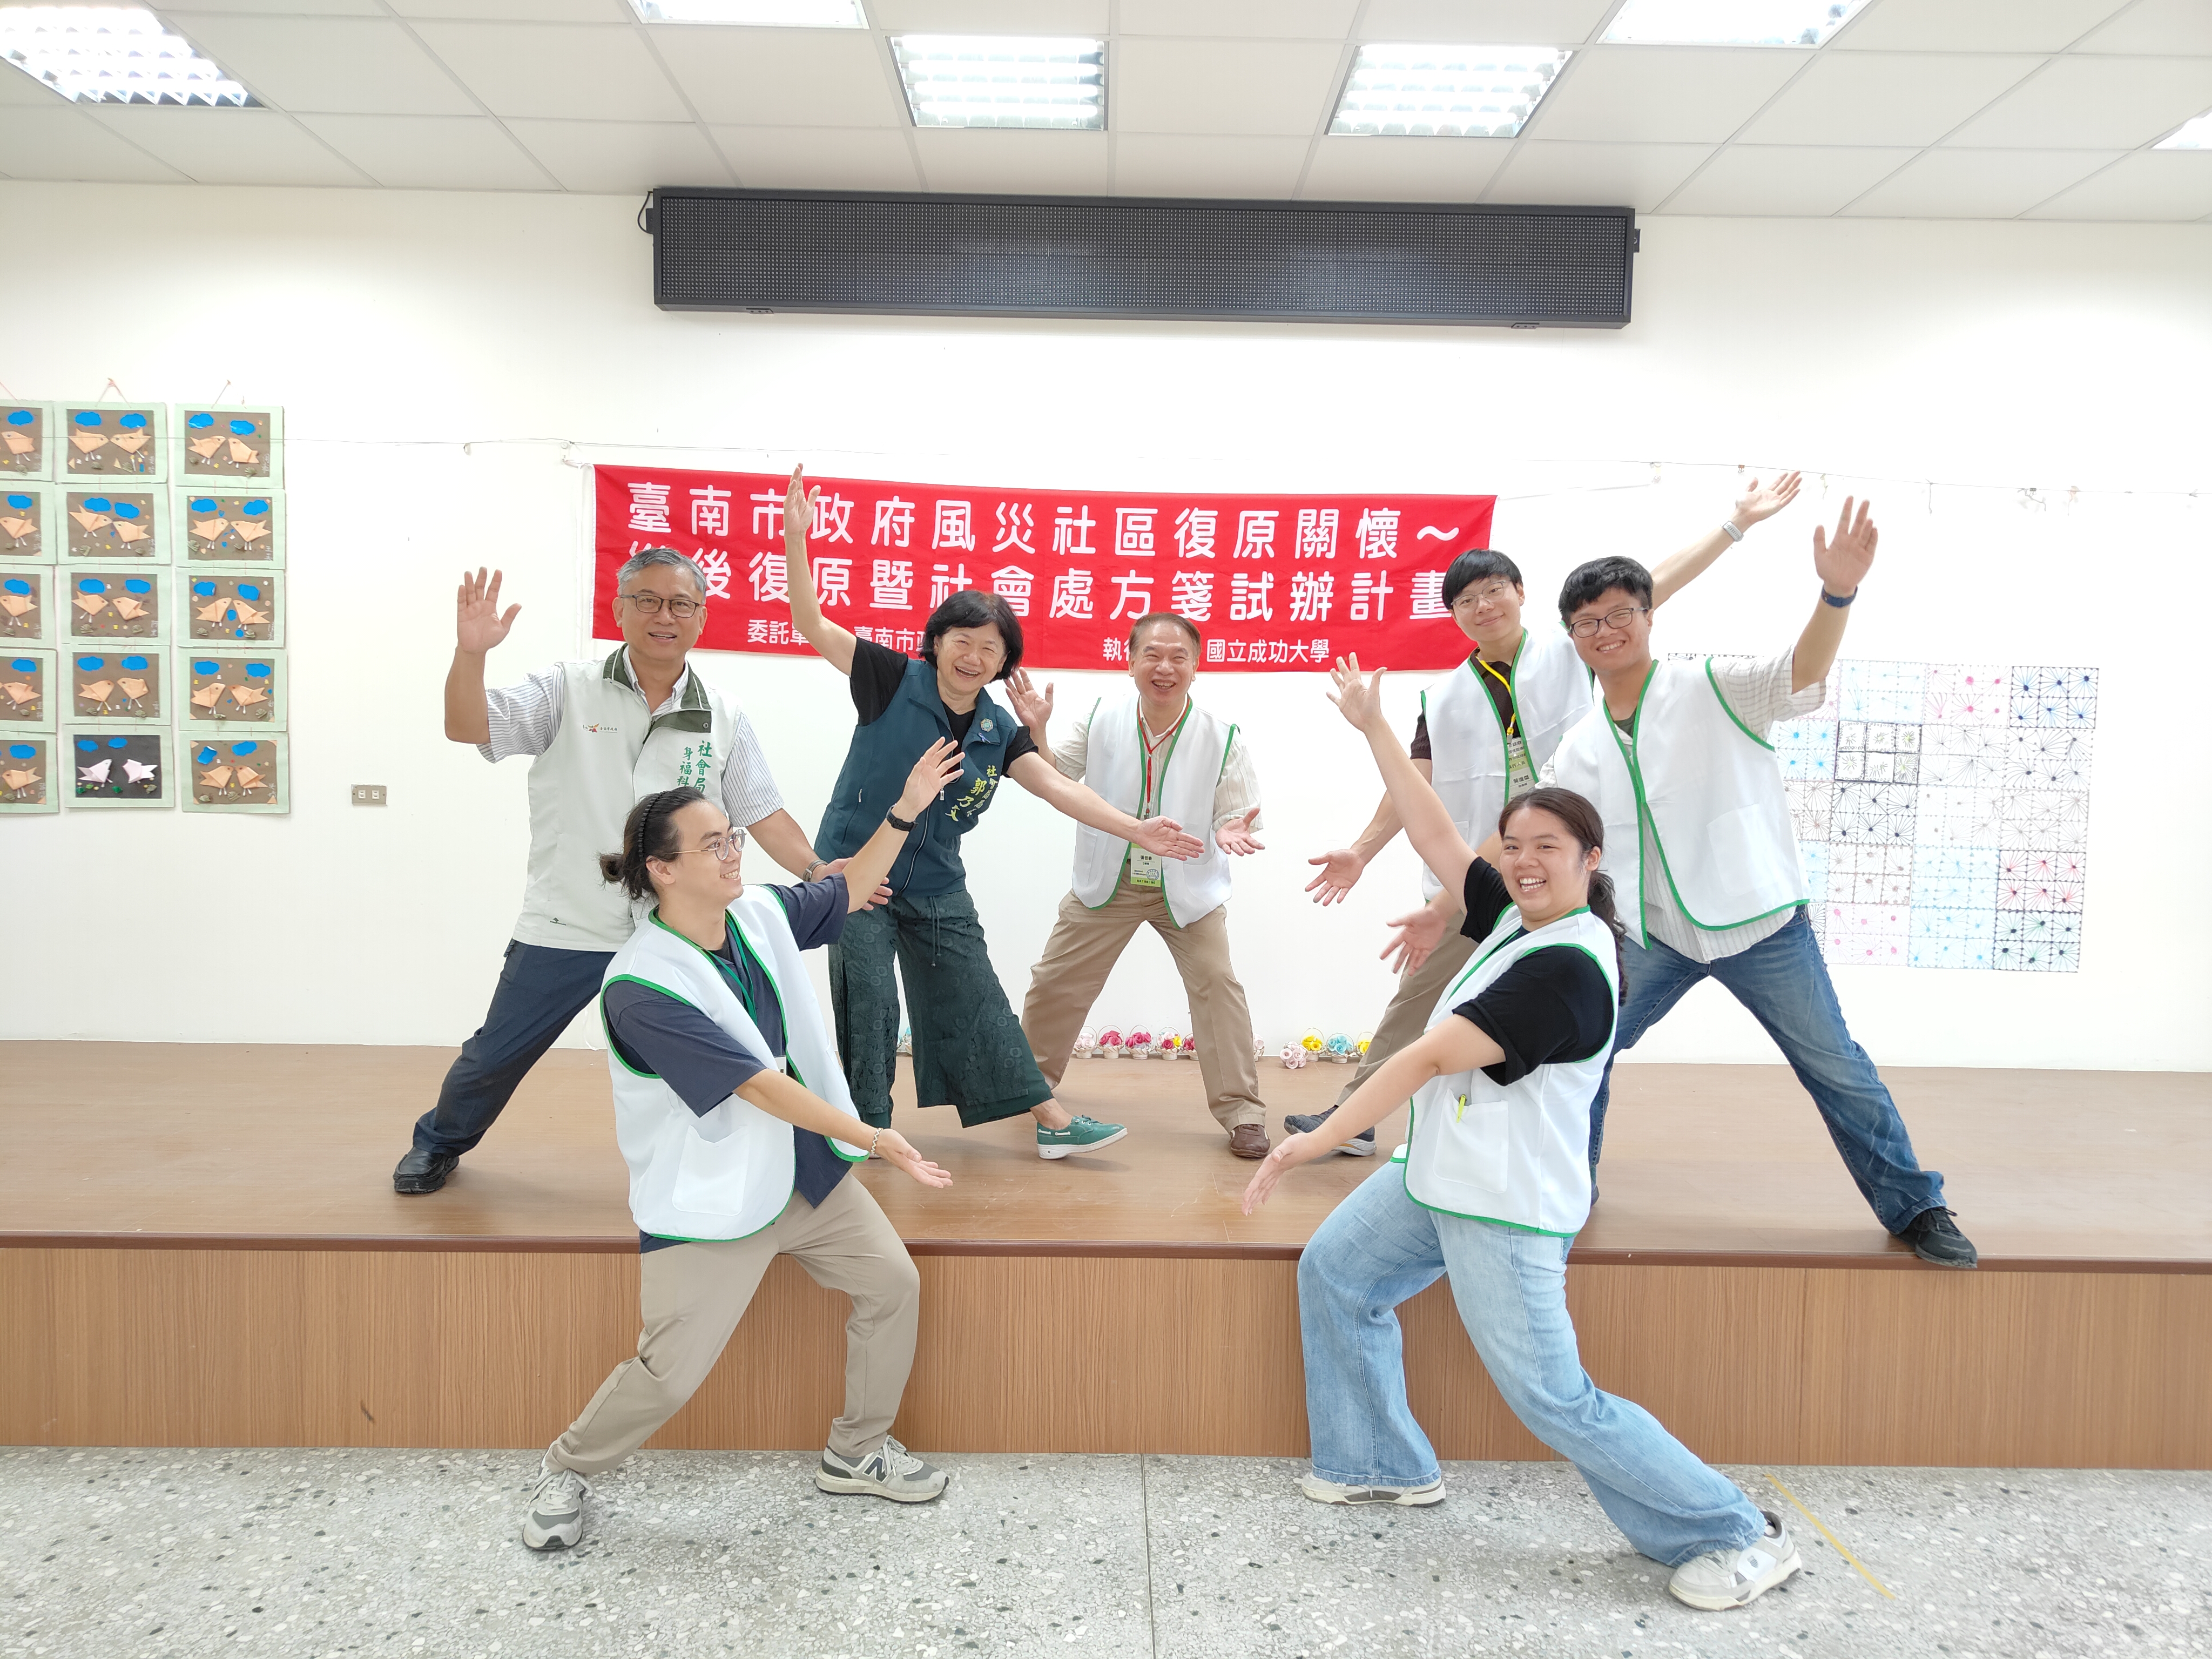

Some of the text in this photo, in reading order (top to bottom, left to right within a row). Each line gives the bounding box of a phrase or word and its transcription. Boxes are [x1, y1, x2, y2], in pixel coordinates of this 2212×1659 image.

[629, 541, 1452, 622] 後復原暨社會處方箋試辦計畫
[1207, 639, 1330, 663] 國立成功大學
[677, 746, 693, 786] 身福科
[693, 740, 712, 793] 社會局
[945, 777, 987, 821] 郭乃文
